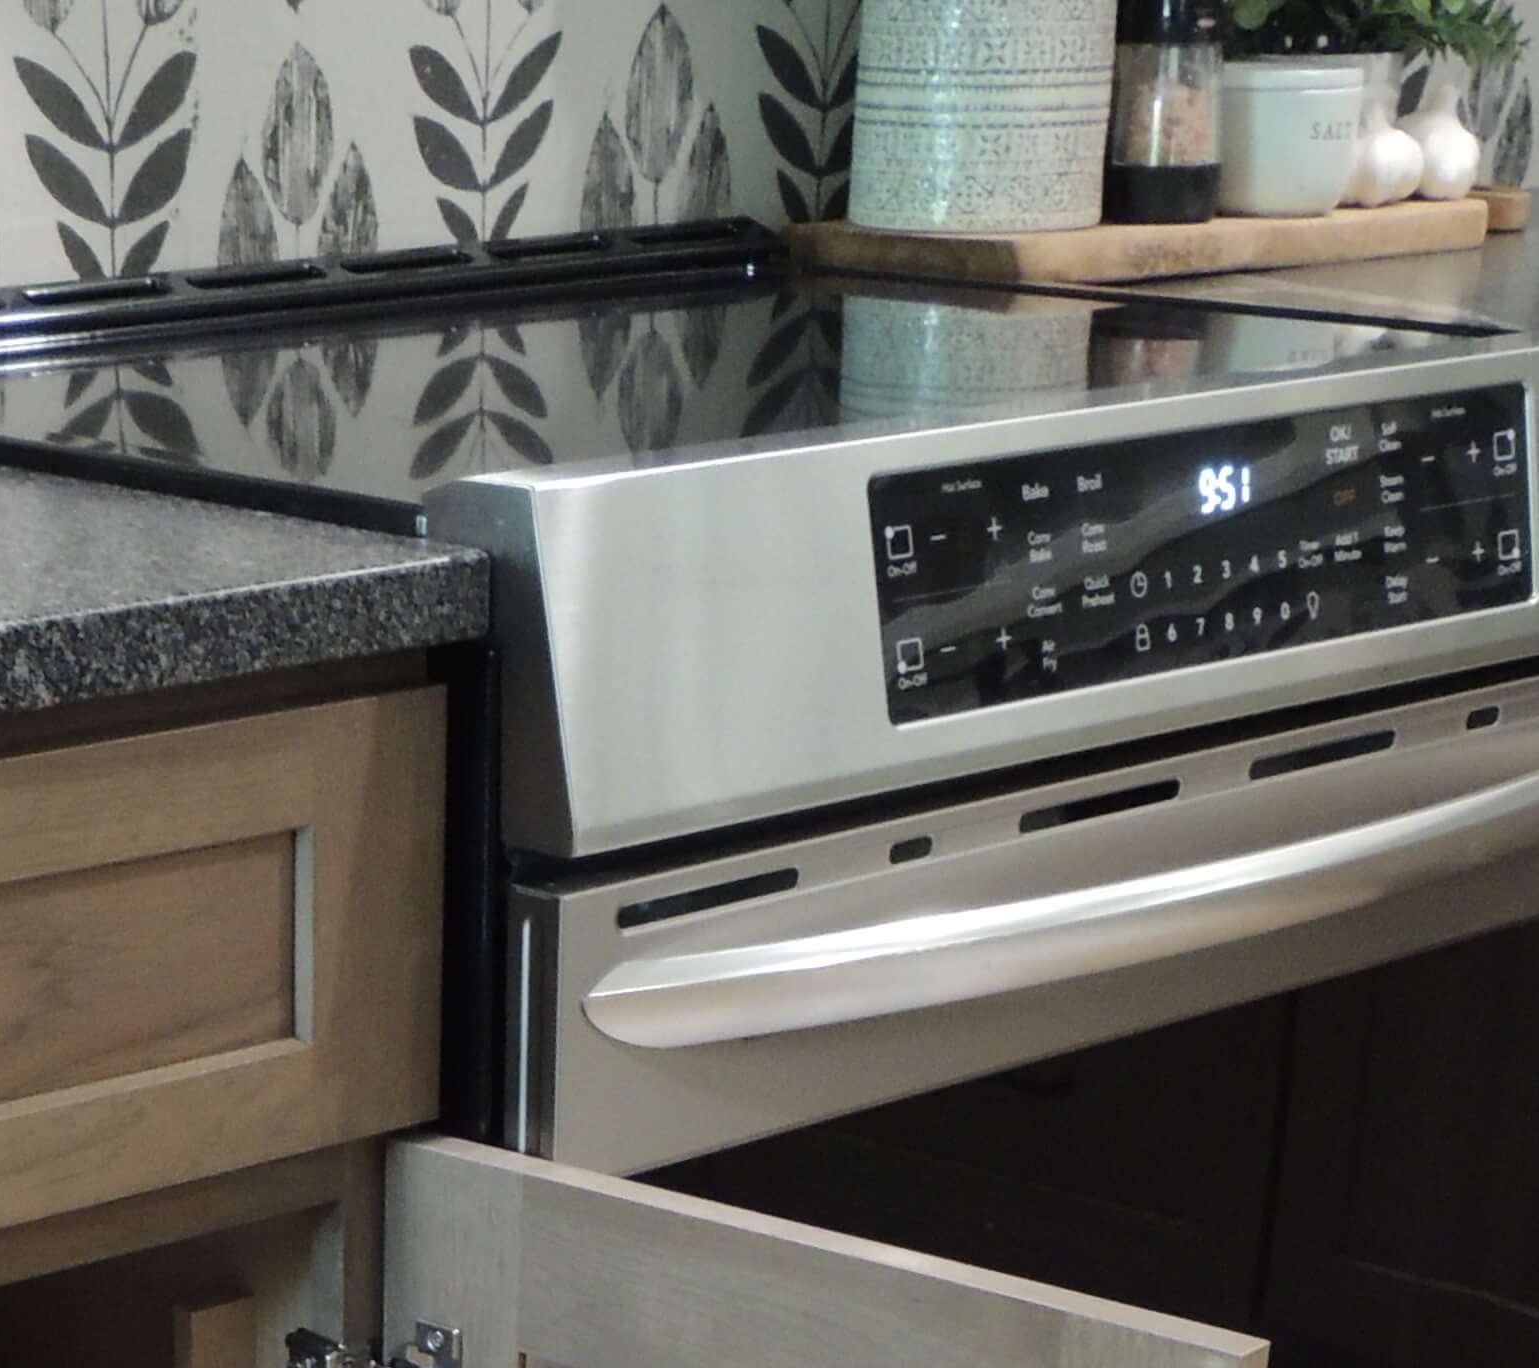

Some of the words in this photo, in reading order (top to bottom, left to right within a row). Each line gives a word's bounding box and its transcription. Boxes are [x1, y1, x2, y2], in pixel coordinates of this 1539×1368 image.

[1325, 445, 1360, 466] START
[1021, 482, 1050, 501] Bake
[1076, 472, 1104, 493] Broil
[1164, 570, 1173, 589] 1
[1192, 564, 1203, 584] 2
[1221, 559, 1232, 580] 3
[1248, 554, 1260, 574] 4
[1277, 549, 1288, 569] 5
[1166, 622, 1178, 643] 6
[1195, 616, 1206, 636] 7
[1224, 611, 1235, 631] 8
[1252, 606, 1263, 626] 9
[1279, 600, 1291, 621] 0
